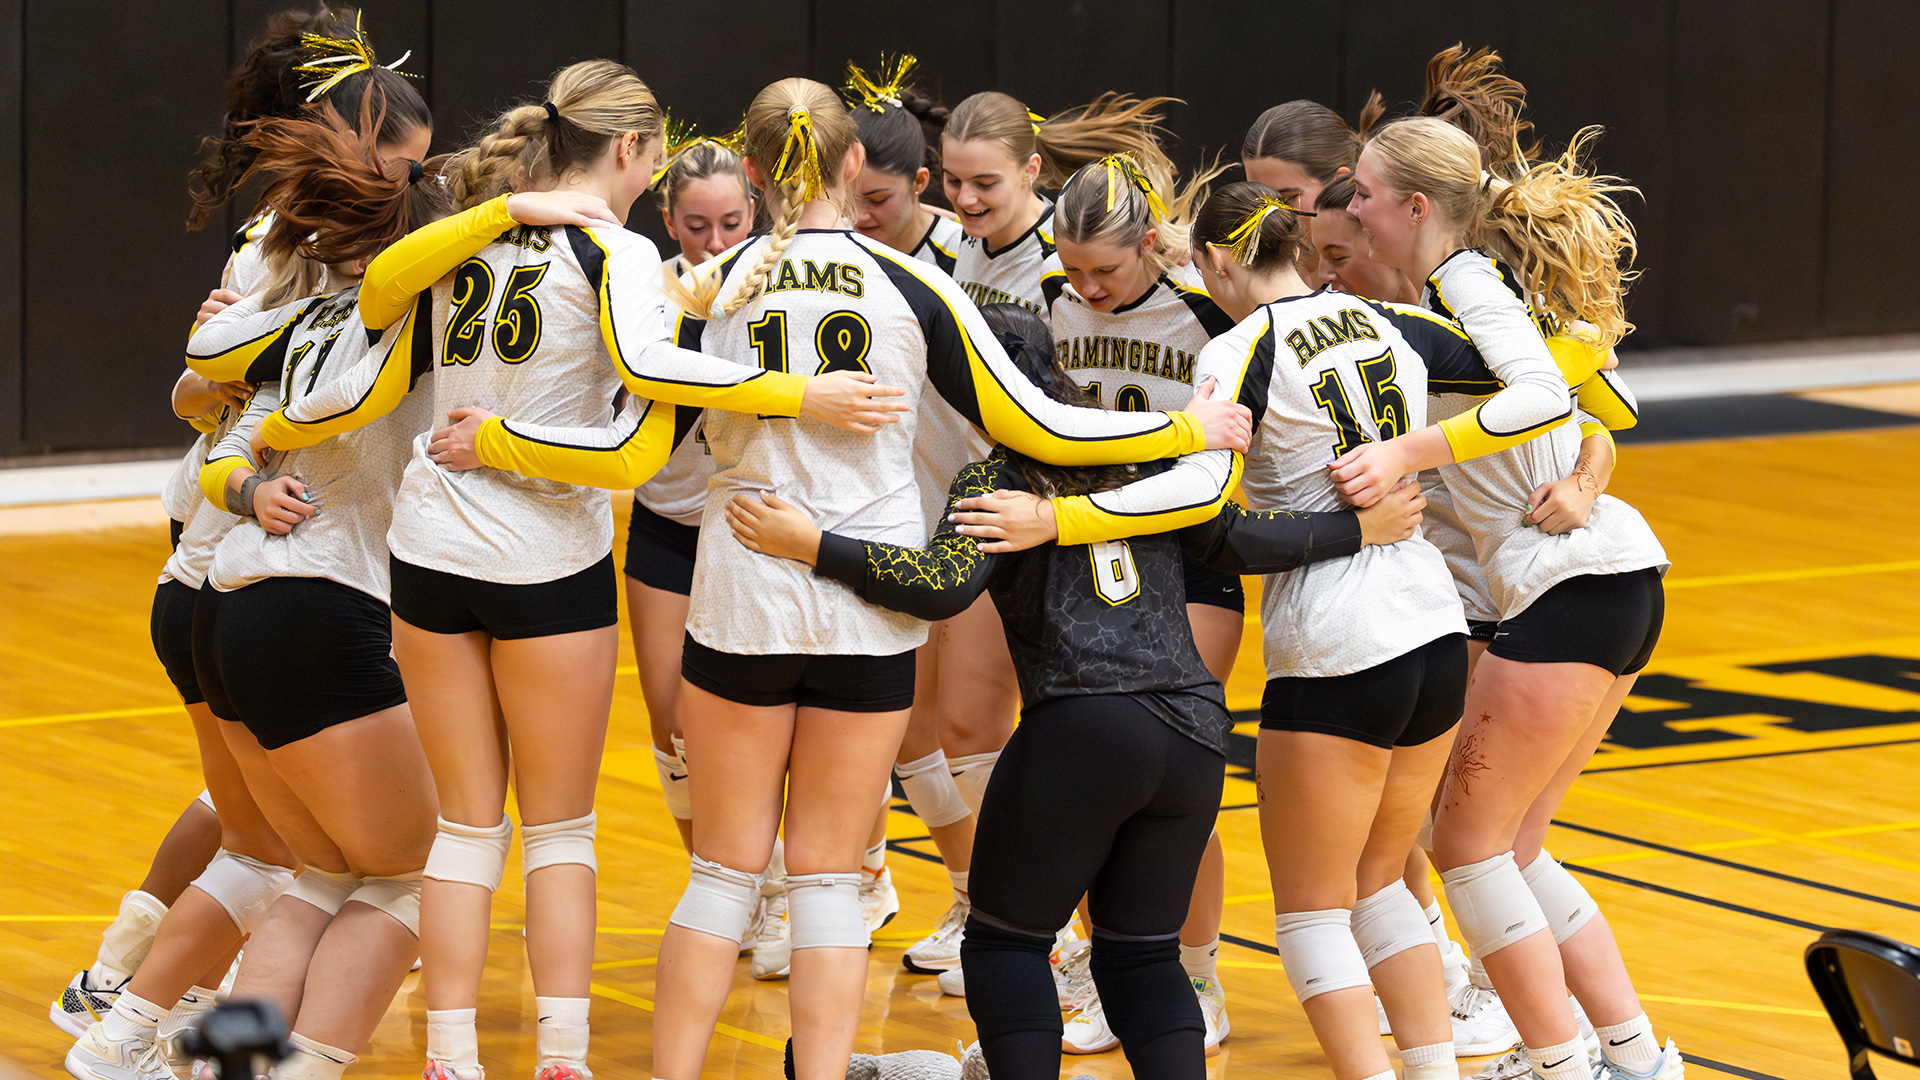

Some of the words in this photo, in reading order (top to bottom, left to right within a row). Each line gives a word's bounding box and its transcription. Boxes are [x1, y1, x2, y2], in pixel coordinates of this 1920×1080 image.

[442, 256, 551, 366] 25
[748, 259, 864, 299] AMS
[747, 310, 873, 419] 18
[1056, 336, 1195, 386] RAMINGHAM
[1284, 309, 1381, 369] RAMS
[1309, 345, 1410, 460] 15
